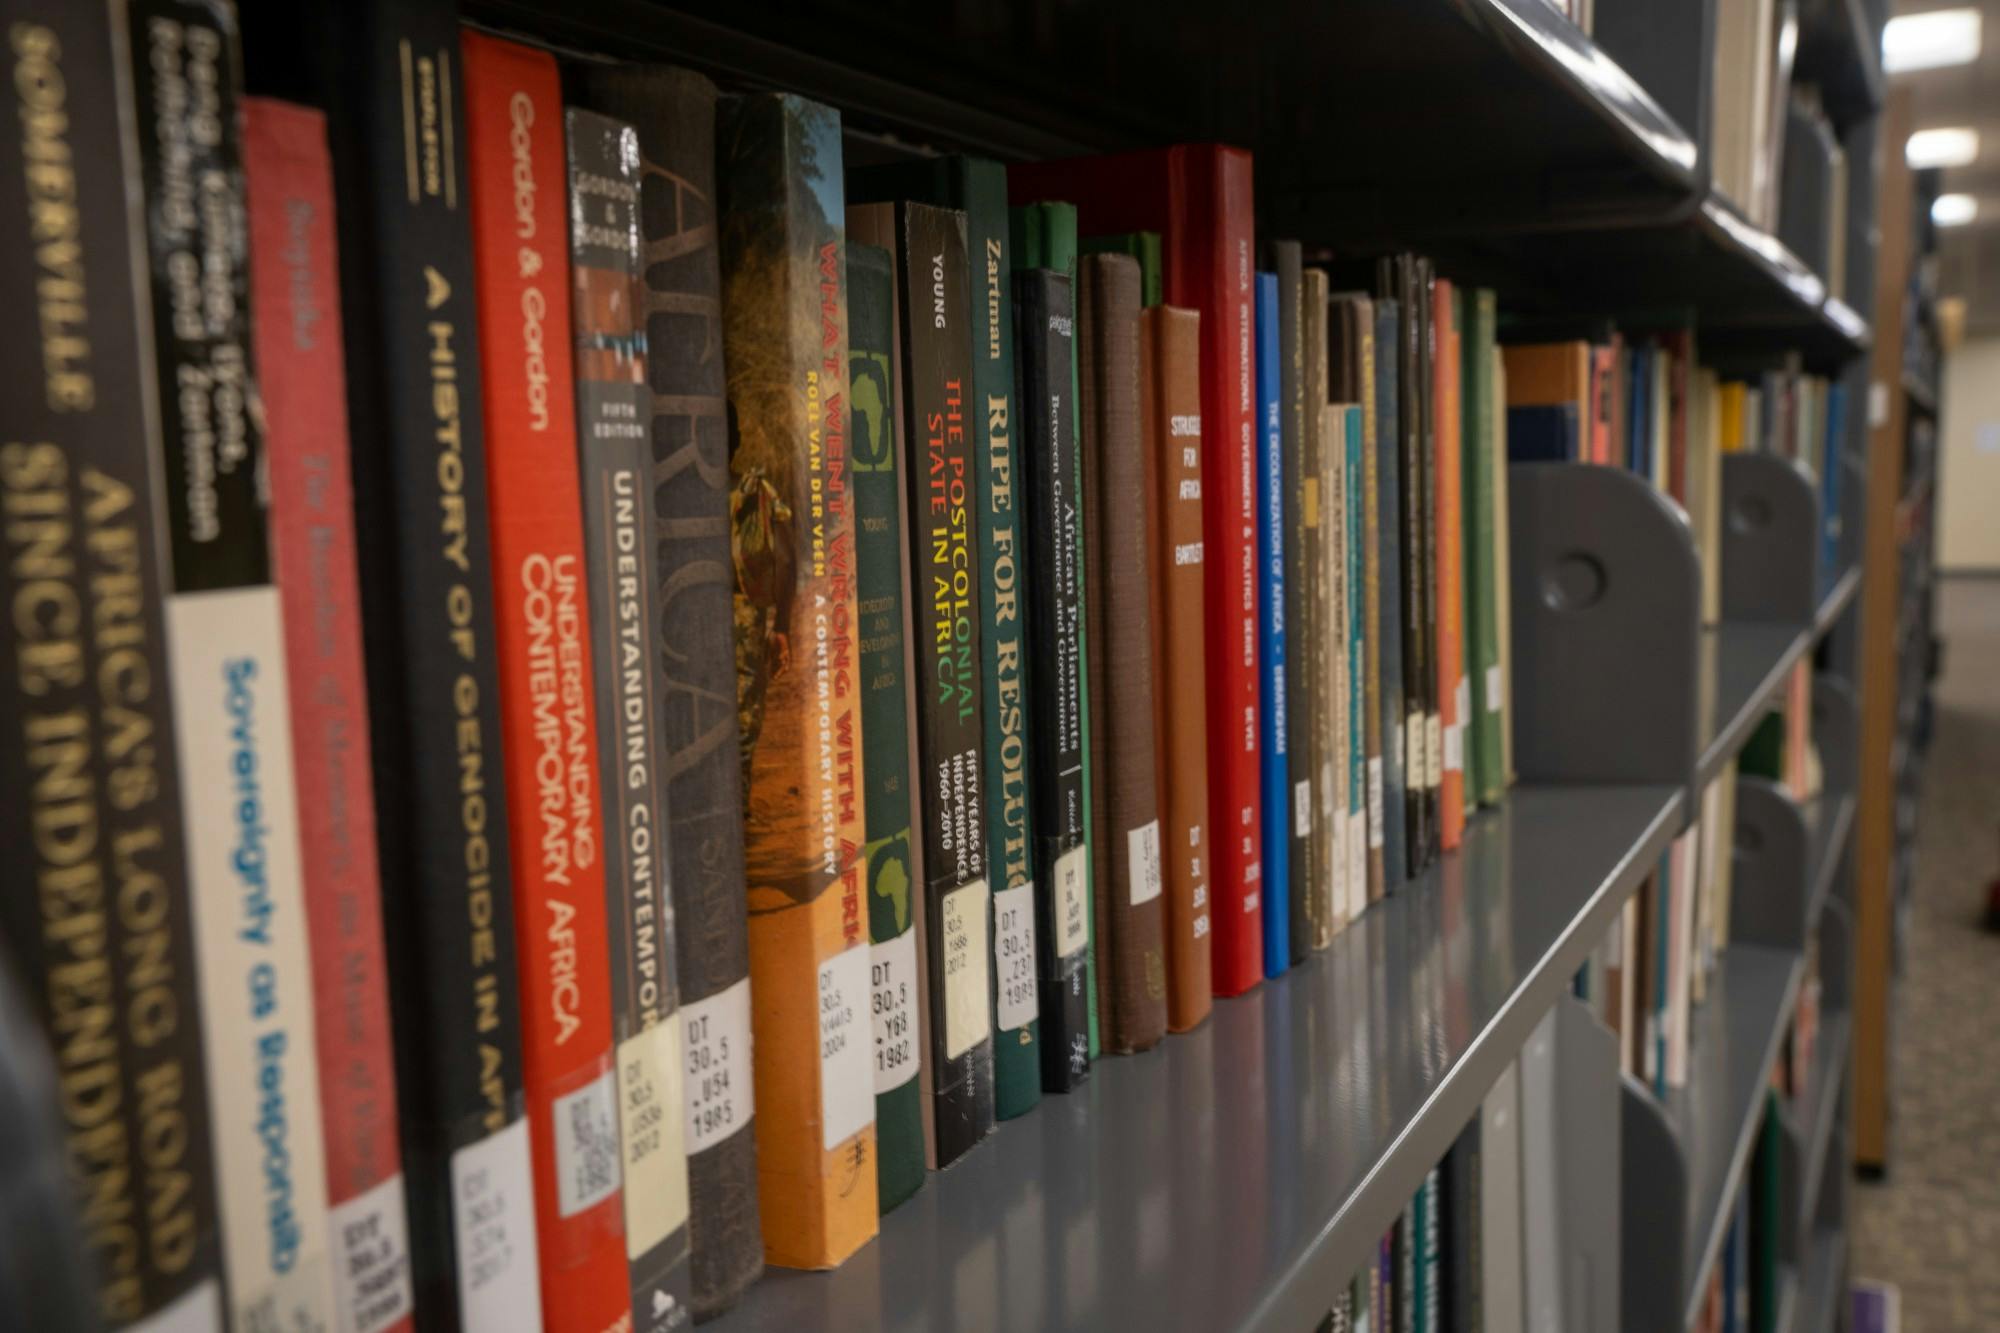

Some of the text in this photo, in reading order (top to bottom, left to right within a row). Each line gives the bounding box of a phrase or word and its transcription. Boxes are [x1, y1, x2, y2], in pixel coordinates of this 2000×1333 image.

[10, 22, 94, 412] SOMERVILLE
[508, 91, 553, 431] Gordon & Gordon
[423, 266, 452, 311] A
[819, 241, 843, 379] WHAT
[932, 254, 947, 329] YOUNG
[986, 239, 1003, 359] Zartman
[1240, 303, 1251, 415] INTERNATIONAL
[1268, 400, 1280, 428] THE
[428, 321, 469, 573] HISTORY
[640, 156, 736, 783] AFRICA
[806, 370, 829, 579] ROEL VAN DER VEEN
[824, 393, 847, 519] WENT
[1241, 422, 1253, 520] GOVERNMENT
[1269, 432, 1283, 555] DECOLONIZATION
[1, 442, 84, 692] SINCE
[928, 412, 957, 706] STATE IN AFRICA
[945, 378, 974, 728] THE POSTCOLONIAL
[1050, 394, 1069, 753] Between Governance and Government
[1063, 504, 1077, 595] African
[1243, 545, 1253, 610] POLITICS
[1271, 558, 1283, 576] OF
[1272, 583, 1285, 634] AFRICA
[447, 583, 476, 665] OF
[830, 532, 860, 701] WRONG
[987, 393, 1028, 891] RIPE FOR RESOLUTIO
[1065, 604, 1081, 751] Parliaments
[1244, 618, 1254, 668] SERIES
[552, 552, 596, 869] UNDERSTANDING
[613, 469, 661, 1033] UNDERSTANDING CONTEMPOR
[813, 593, 840, 877] A CONTEMPORARY HISTORY
[836, 709, 859, 829] WITH
[221, 656, 293, 946] Sovereignty
[453, 675, 495, 965] GENOCIDE
[521, 552, 582, 1047] CONTEMPORARY AFRICA
[951, 753, 971, 887] INDEPENDENCE,
[965, 748, 982, 875] FIFTY YEARS OF
[112, 826, 180, 1050] LONG
[871, 961, 892, 987] DT
[1001, 908, 1017, 932] DT
[1003, 929, 1031, 957] 30.5
[246, 961, 277, 1021] as
[475, 974, 502, 1033] IN
[688, 1014, 710, 1046] DT
[873, 982, 908, 1016] 30.5
[876, 1010, 908, 1046] .Y68
[689, 1036, 730, 1076] 30.5
[692, 1069, 731, 1108] .U54
[876, 1040, 911, 1073] 1982
[134, 1060, 198, 1276] ROAD
[256, 1029, 304, 1276] Responsib
[692, 1098, 735, 1139] 1985
